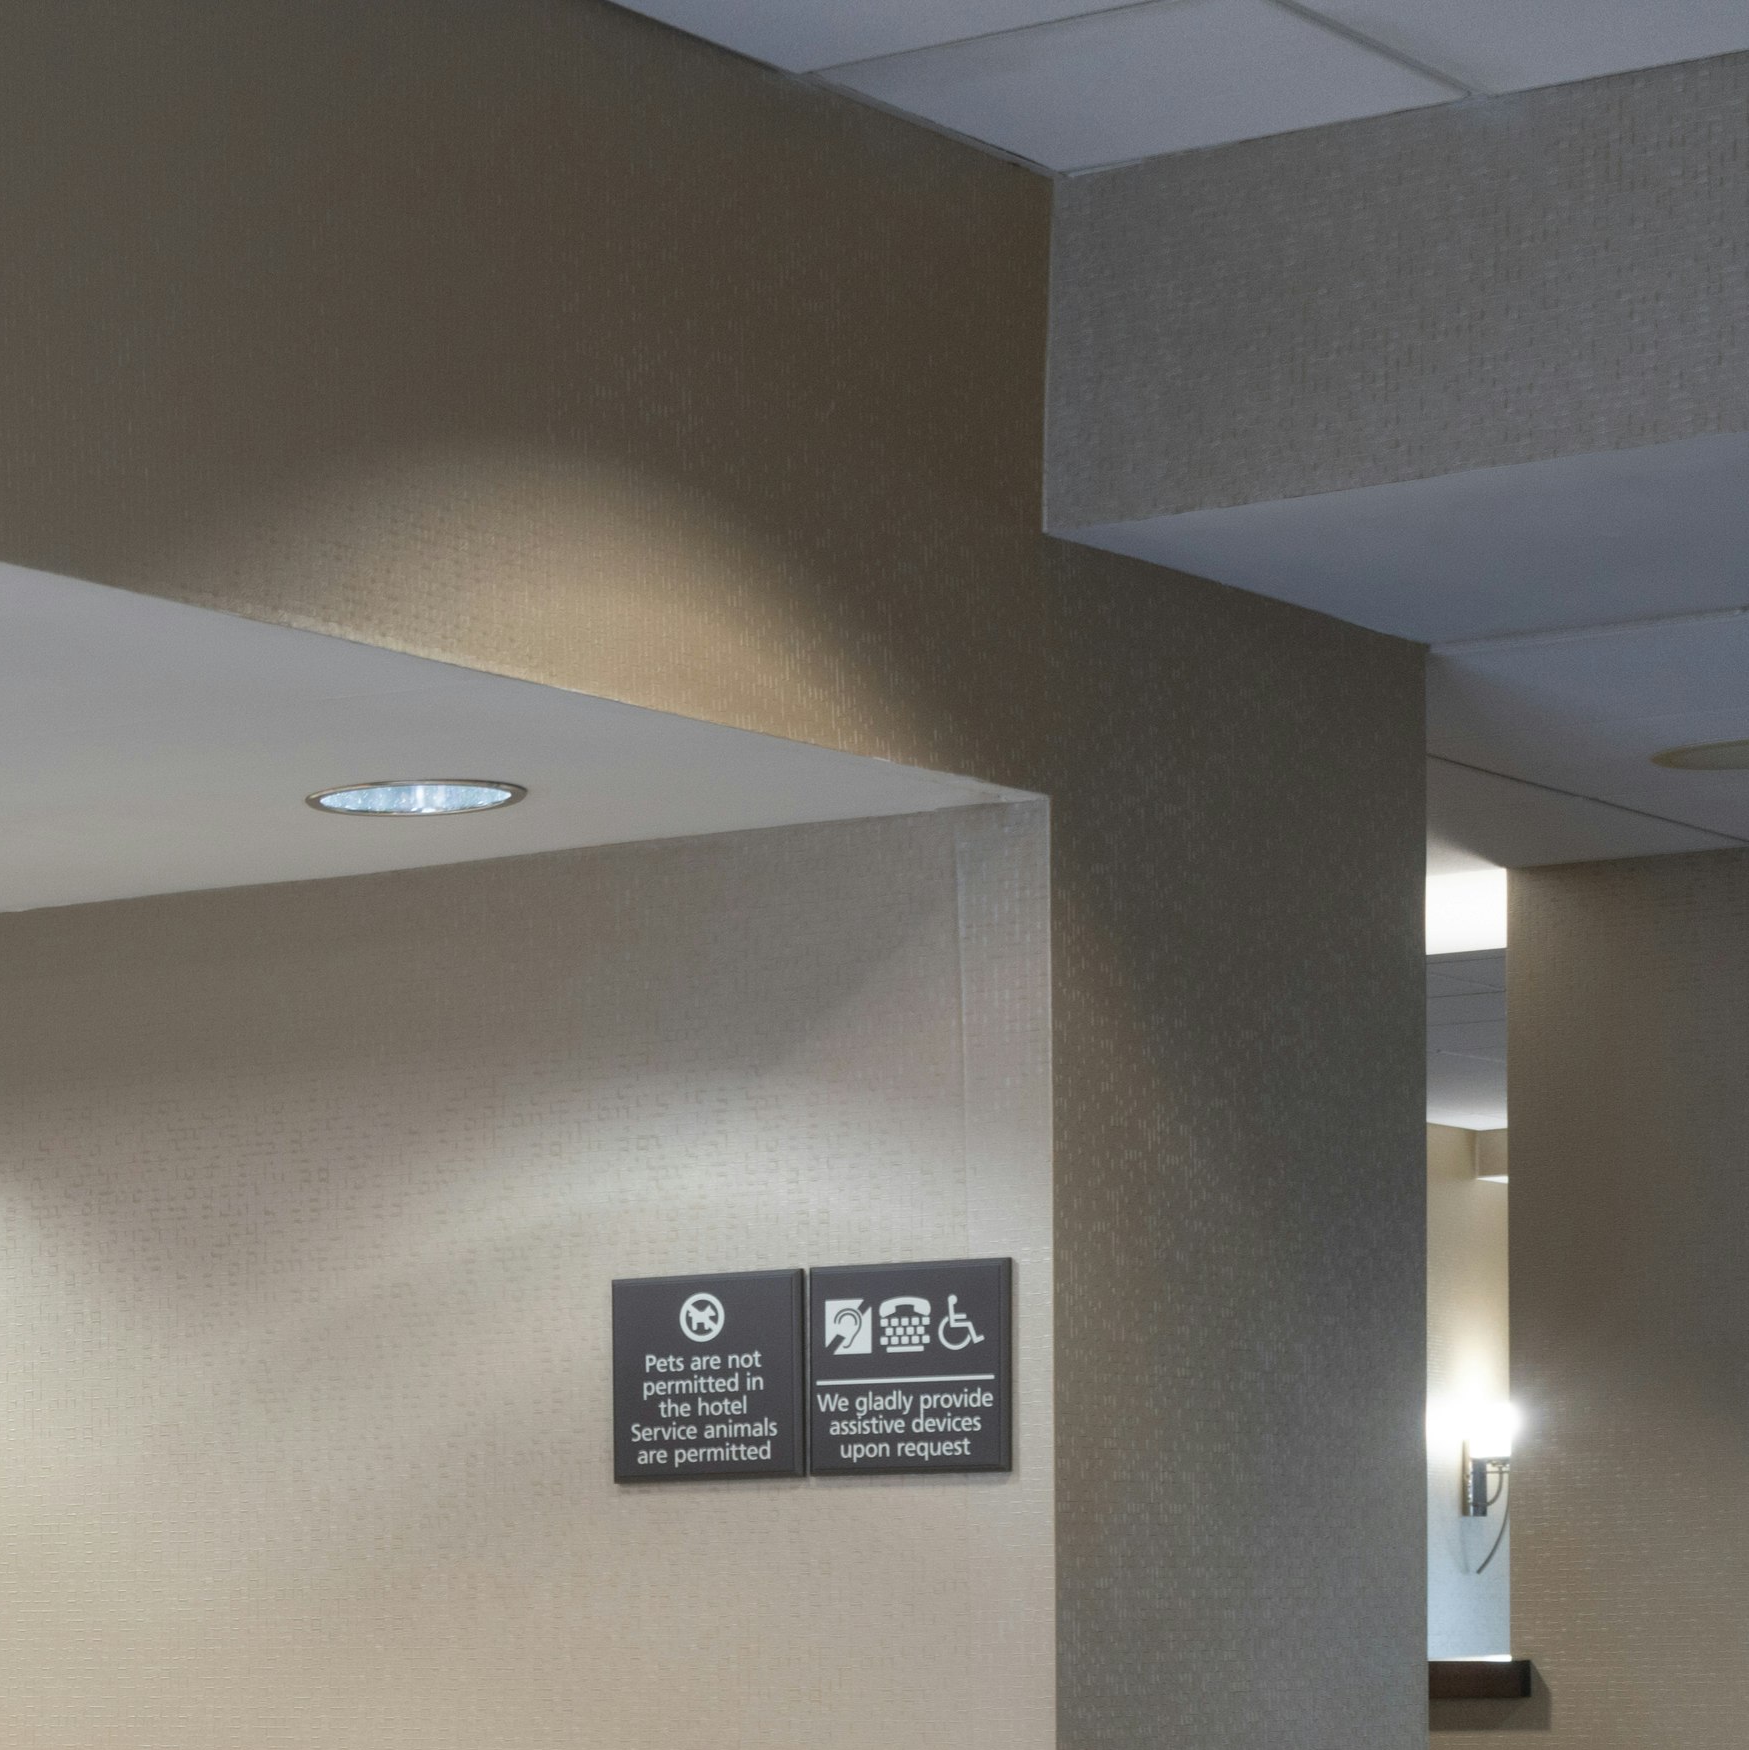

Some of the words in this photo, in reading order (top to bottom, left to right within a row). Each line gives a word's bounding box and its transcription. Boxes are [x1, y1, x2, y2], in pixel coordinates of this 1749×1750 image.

[645, 1354, 684, 1373] Pets
[690, 1355, 721, 1371] are
[728, 1350, 762, 1369] not
[643, 1372, 739, 1400] permitted
[746, 1372, 764, 1391] in
[658, 1398, 691, 1418] the
[698, 1395, 747, 1416] hotel
[816, 1393, 849, 1412] We
[855, 1390, 913, 1416] gladly
[920, 1387, 994, 1417] provide
[631, 1421, 698, 1442] Service
[704, 1417, 778, 1439] animals
[829, 1415, 905, 1435] assistive
[912, 1413, 981, 1433] devices
[637, 1450, 668, 1465] are
[674, 1439, 771, 1468] permitted
[840, 1442, 890, 1463] upon
[897, 1437, 971, 1461] request
